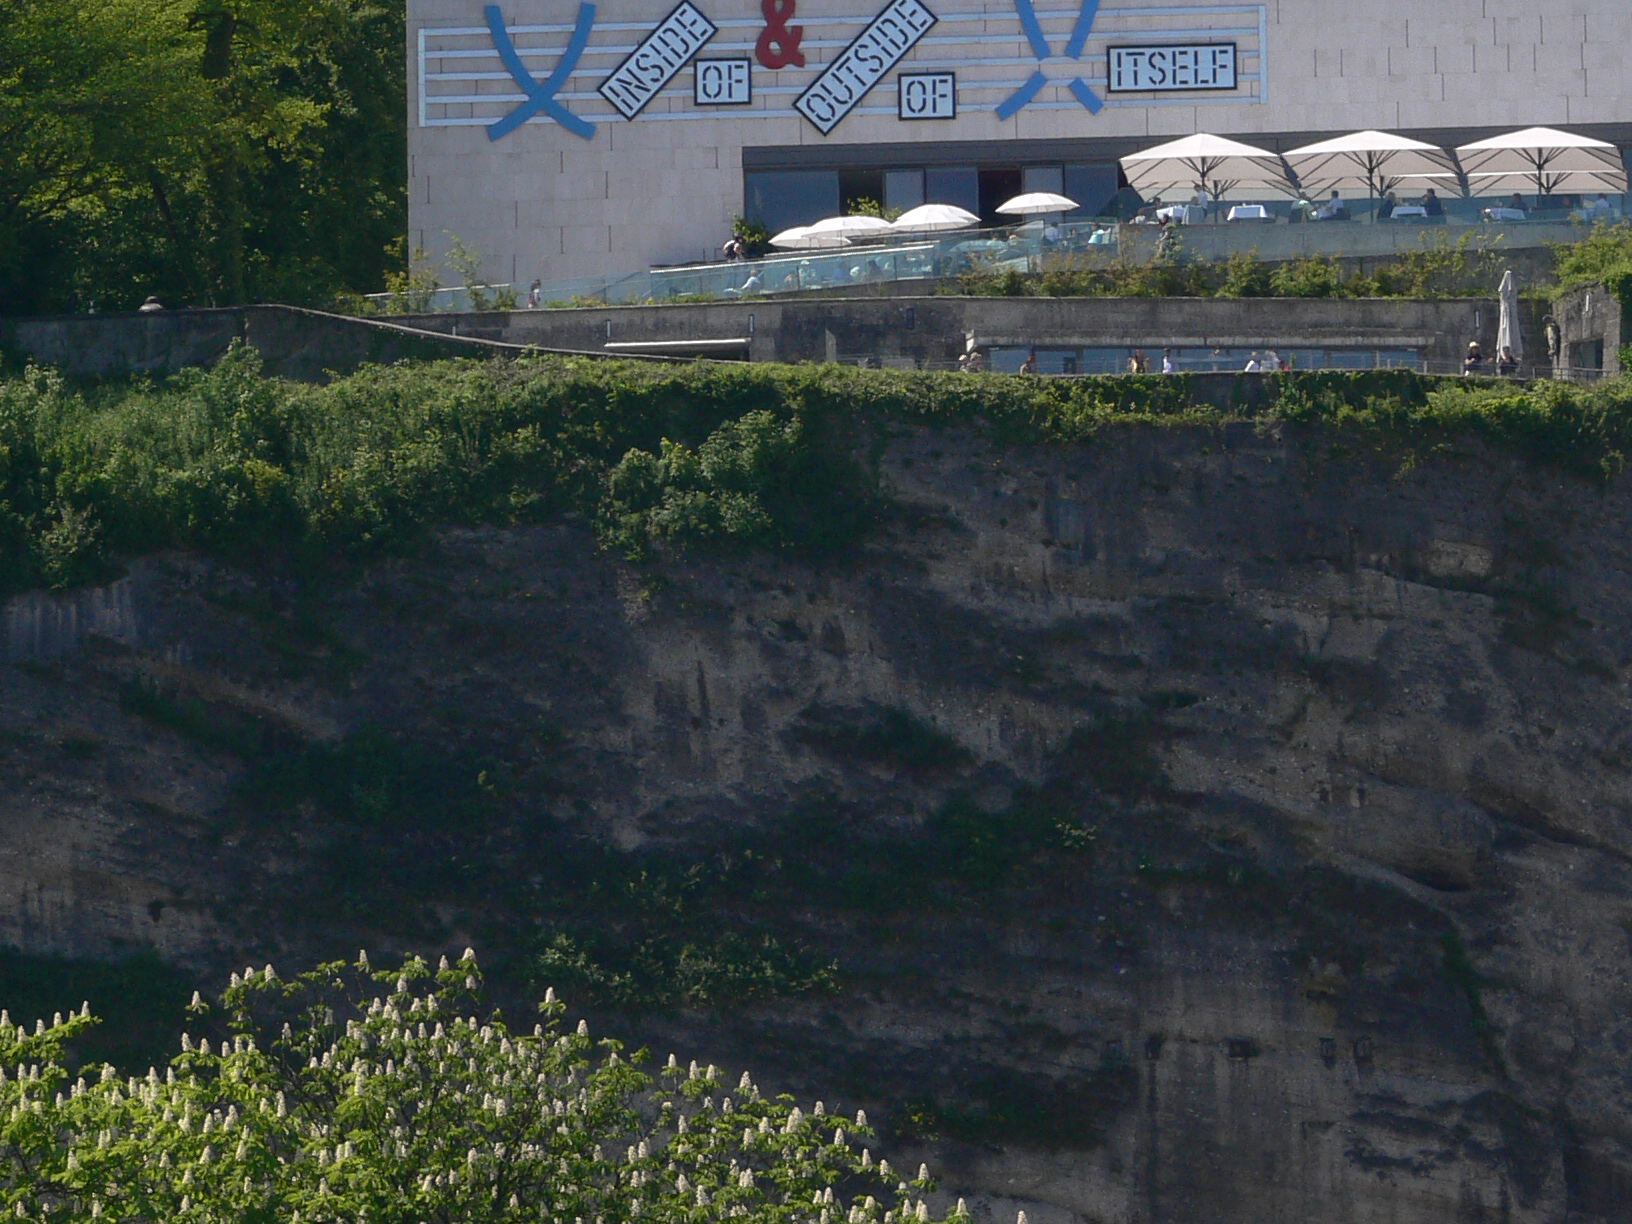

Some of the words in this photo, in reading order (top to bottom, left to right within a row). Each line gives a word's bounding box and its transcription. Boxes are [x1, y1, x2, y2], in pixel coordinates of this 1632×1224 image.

[607, 8, 710, 112] INSIDE
[701, 63, 745, 100] OF
[905, 78, 949, 115] OF
[1115, 49, 1229, 87] ITSELF
